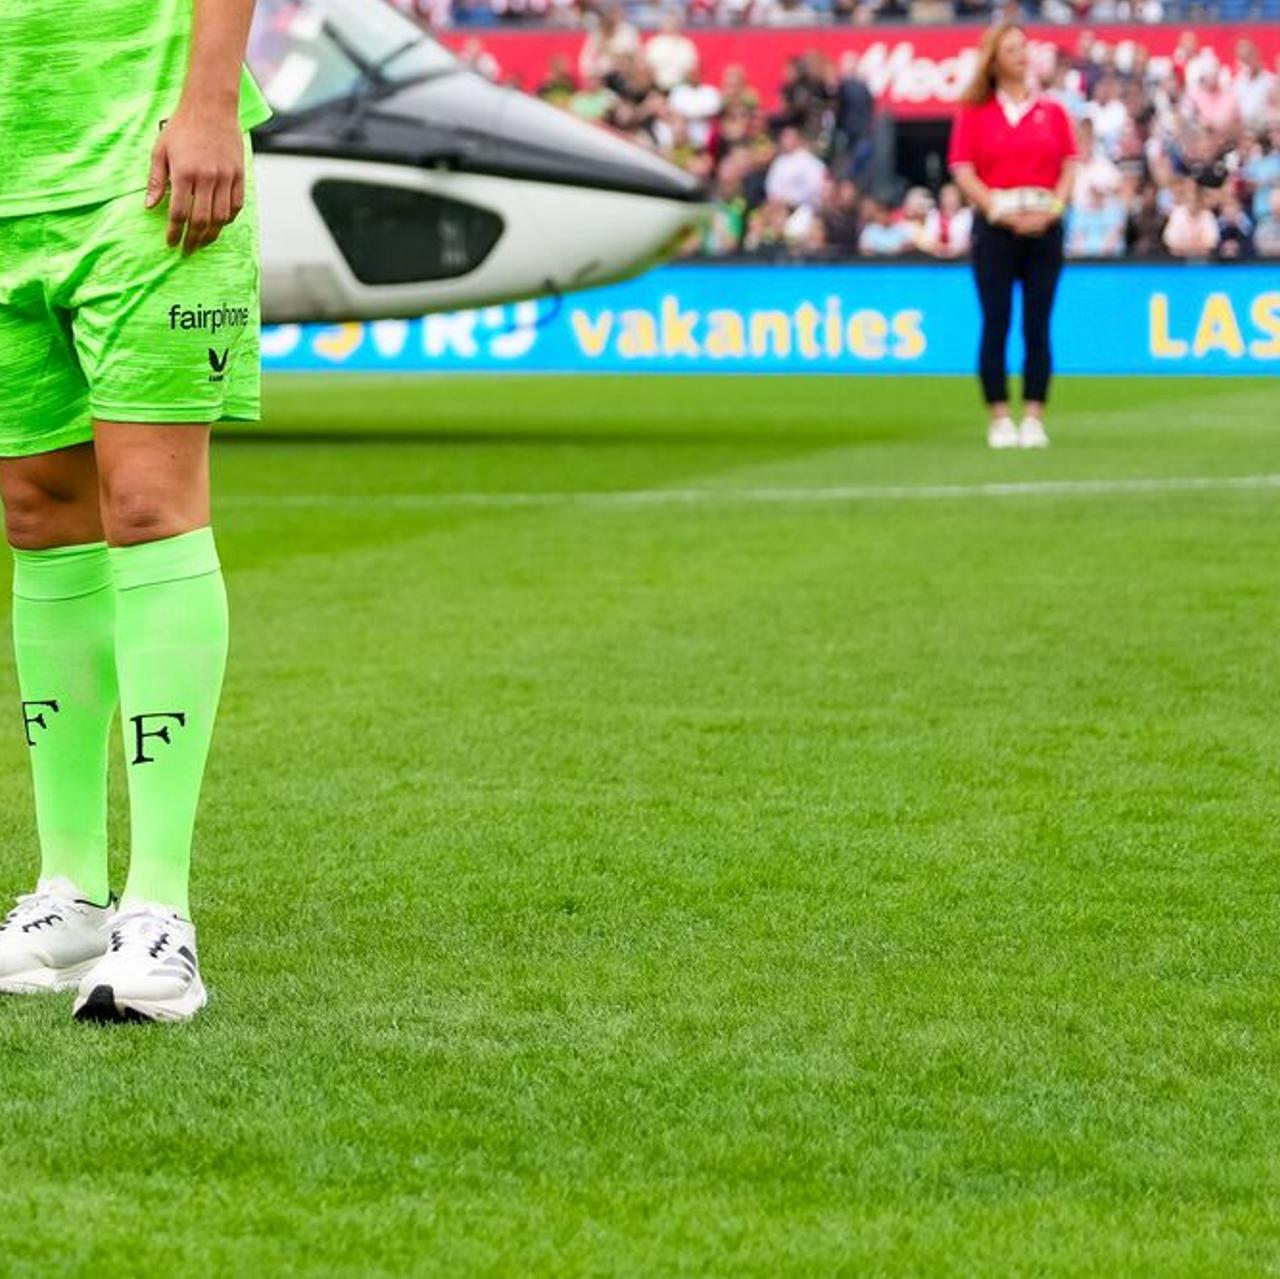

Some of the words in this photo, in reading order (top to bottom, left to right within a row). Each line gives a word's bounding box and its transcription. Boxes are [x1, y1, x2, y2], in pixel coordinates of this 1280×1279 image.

[857, 40, 980, 103] Med
[570, 294, 928, 360] vakanties
[21, 699, 60, 747] F
[130, 712, 186, 765] F
